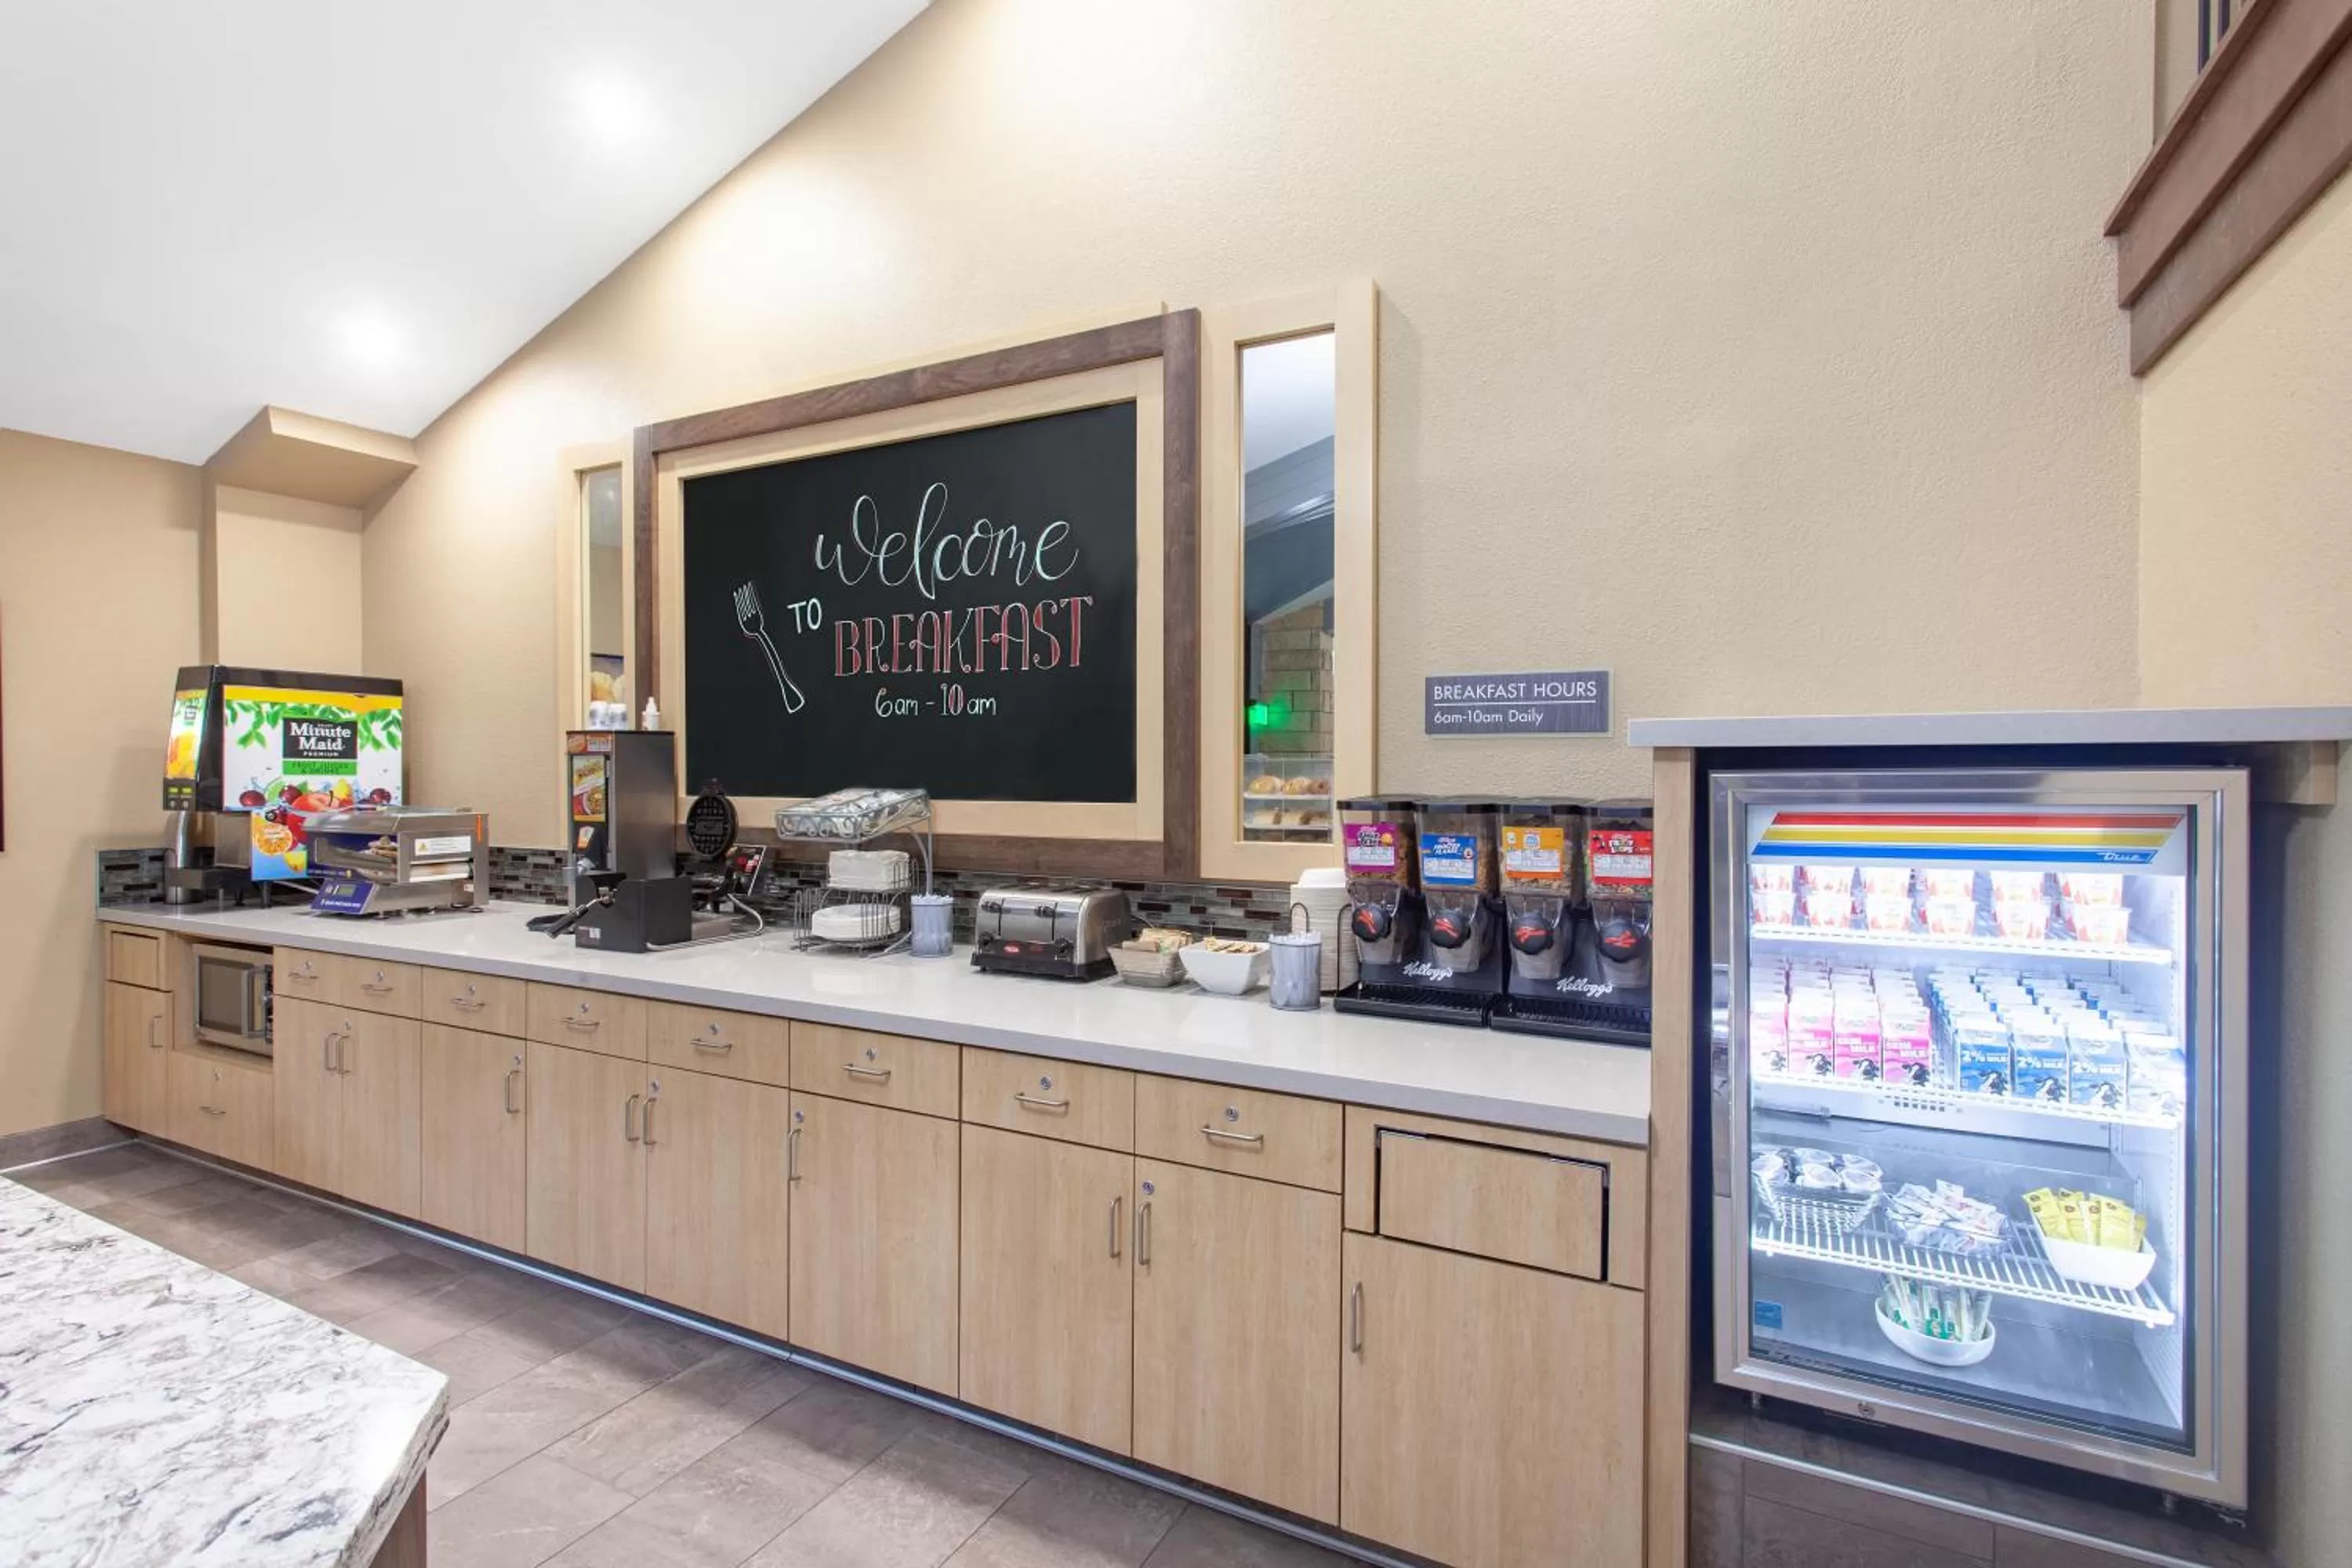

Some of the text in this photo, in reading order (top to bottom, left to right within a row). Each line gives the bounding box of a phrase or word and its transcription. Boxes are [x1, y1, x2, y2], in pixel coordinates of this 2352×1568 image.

[787, 597, 822, 633] TO
[833, 596, 1094, 677] BREAKFAST
[1433, 681, 1598, 701] BREAKFAST HOURS
[875, 688, 918, 717] 6am
[1434, 708, 1544, 726] 6am-10am Daily
[289, 722, 352, 738] Minute
[299, 737, 343, 750] Maid
[1402, 960, 1454, 981] Kellogg's
[1555, 975, 1614, 998] Kellogg's
[1962, 1050, 1985, 1062] 2%
[2018, 1056, 2042, 1068] 2%
